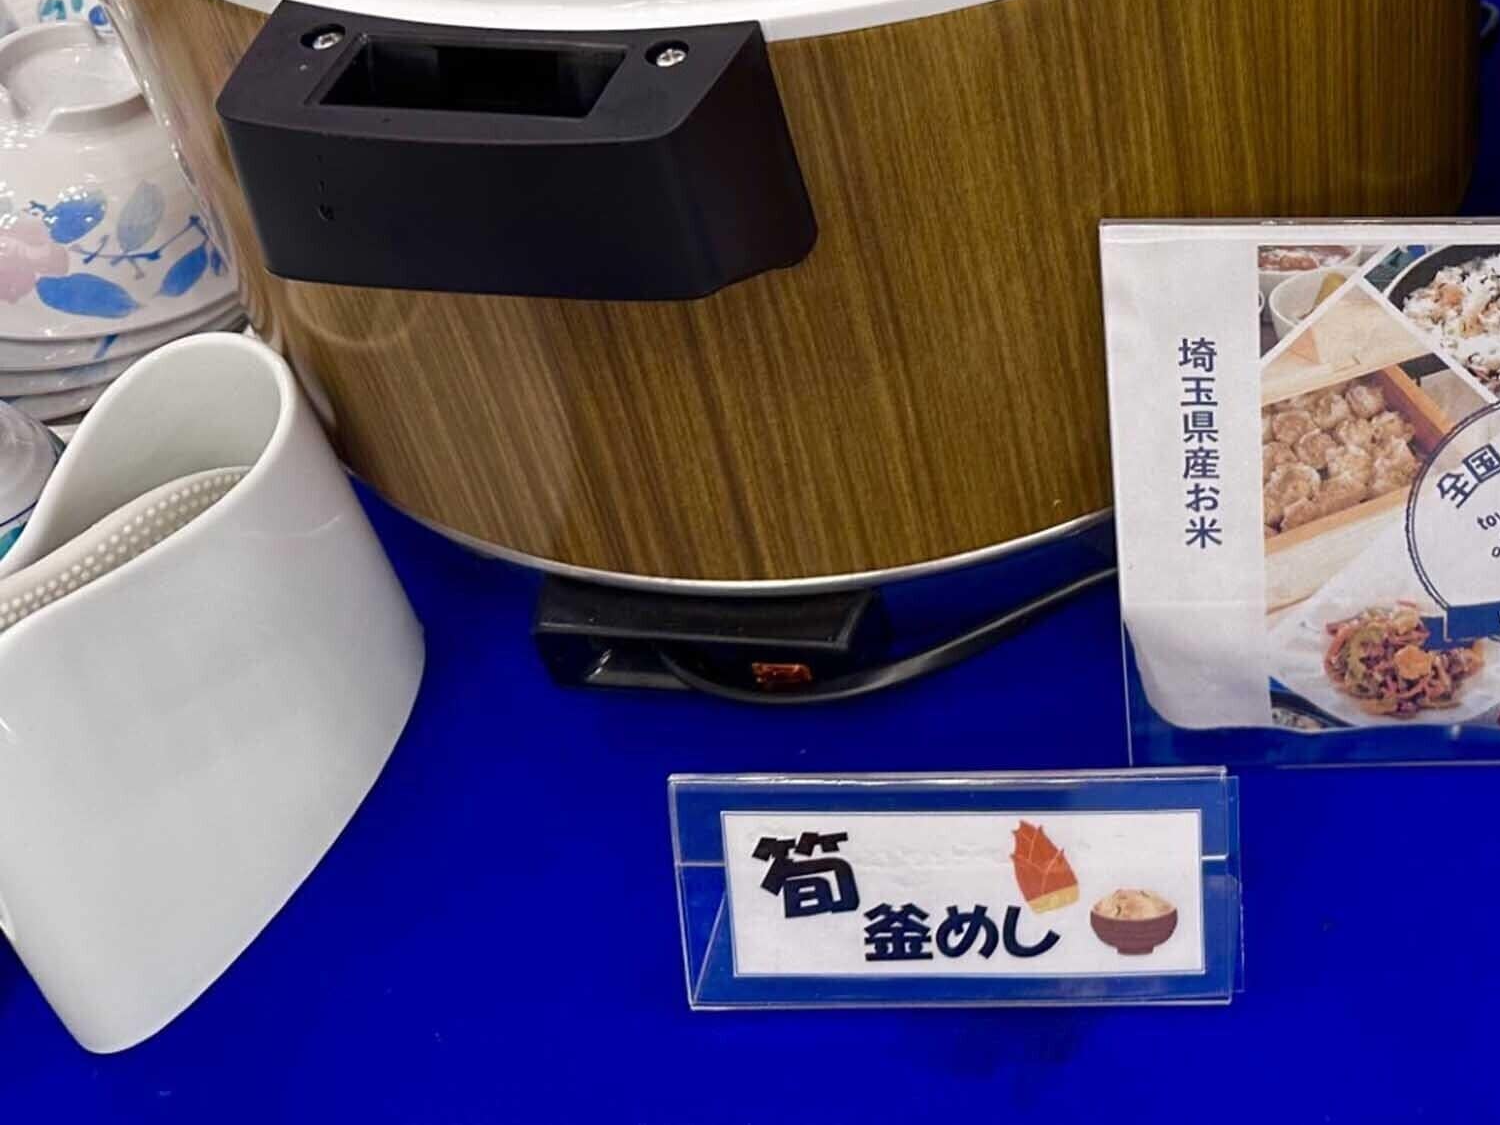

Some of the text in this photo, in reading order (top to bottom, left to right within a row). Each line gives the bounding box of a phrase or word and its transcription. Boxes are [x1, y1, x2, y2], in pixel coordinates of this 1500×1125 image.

[1177, 336, 1223, 550] 埼玉県産お米
[751, 830, 861, 919] 筍
[862, 902, 1061, 962] 釜めし
